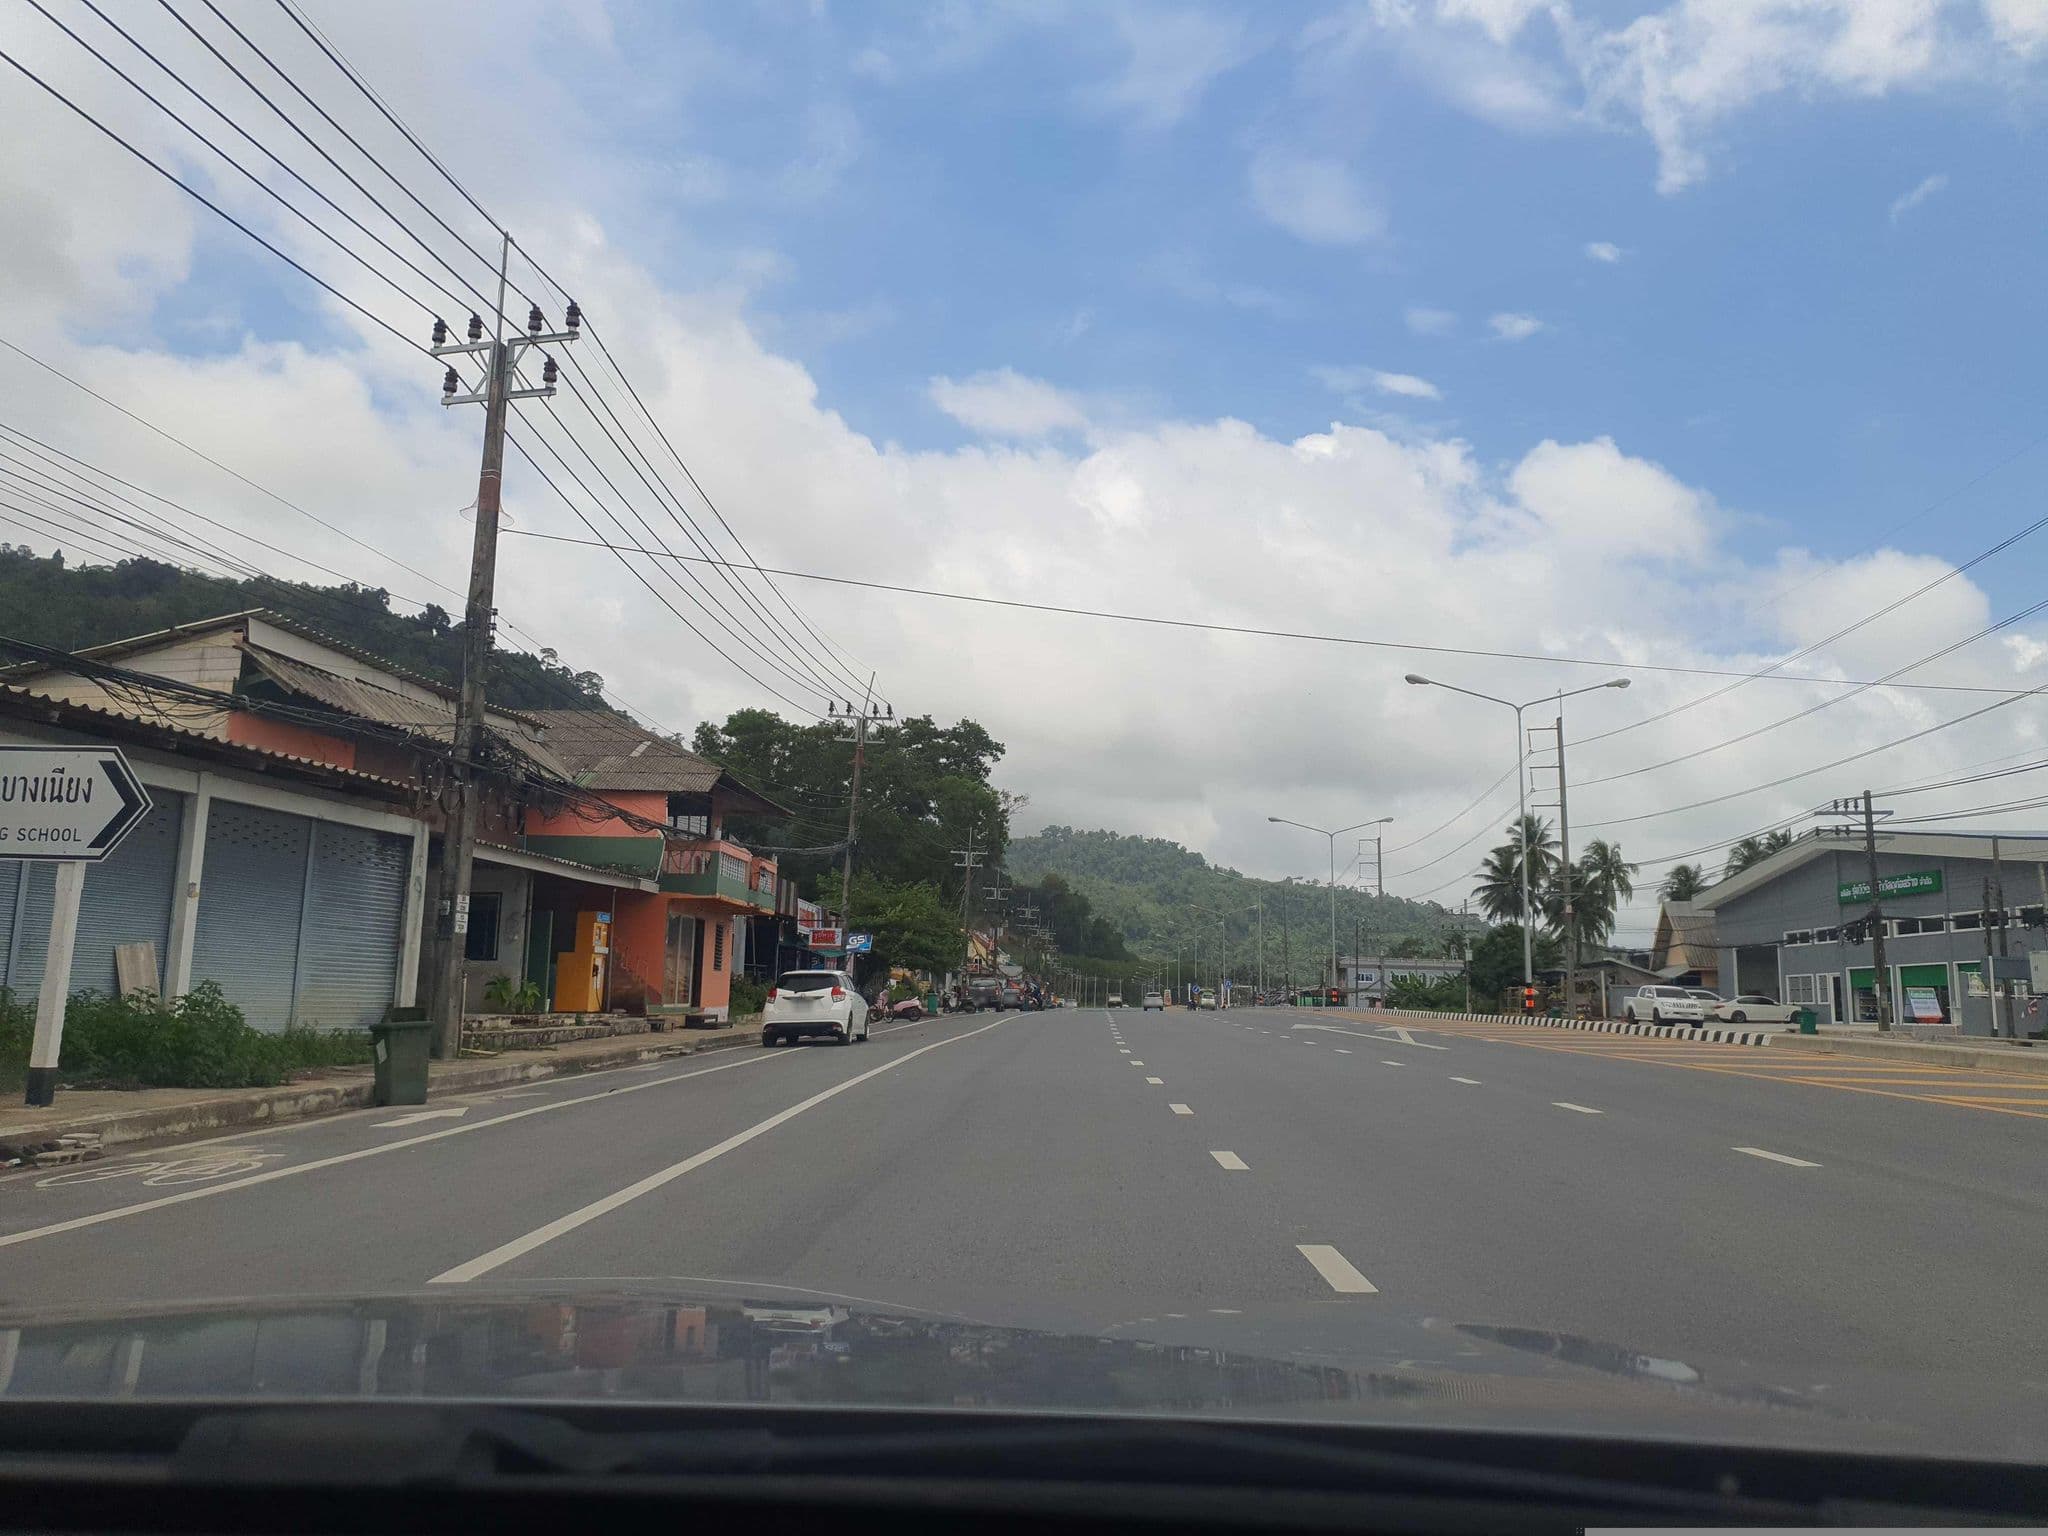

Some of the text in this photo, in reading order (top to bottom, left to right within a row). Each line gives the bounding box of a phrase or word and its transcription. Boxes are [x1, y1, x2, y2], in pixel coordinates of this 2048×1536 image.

[2, 767, 93, 803] บางเนียง
[17, 828, 82, 841] SCHOOL
